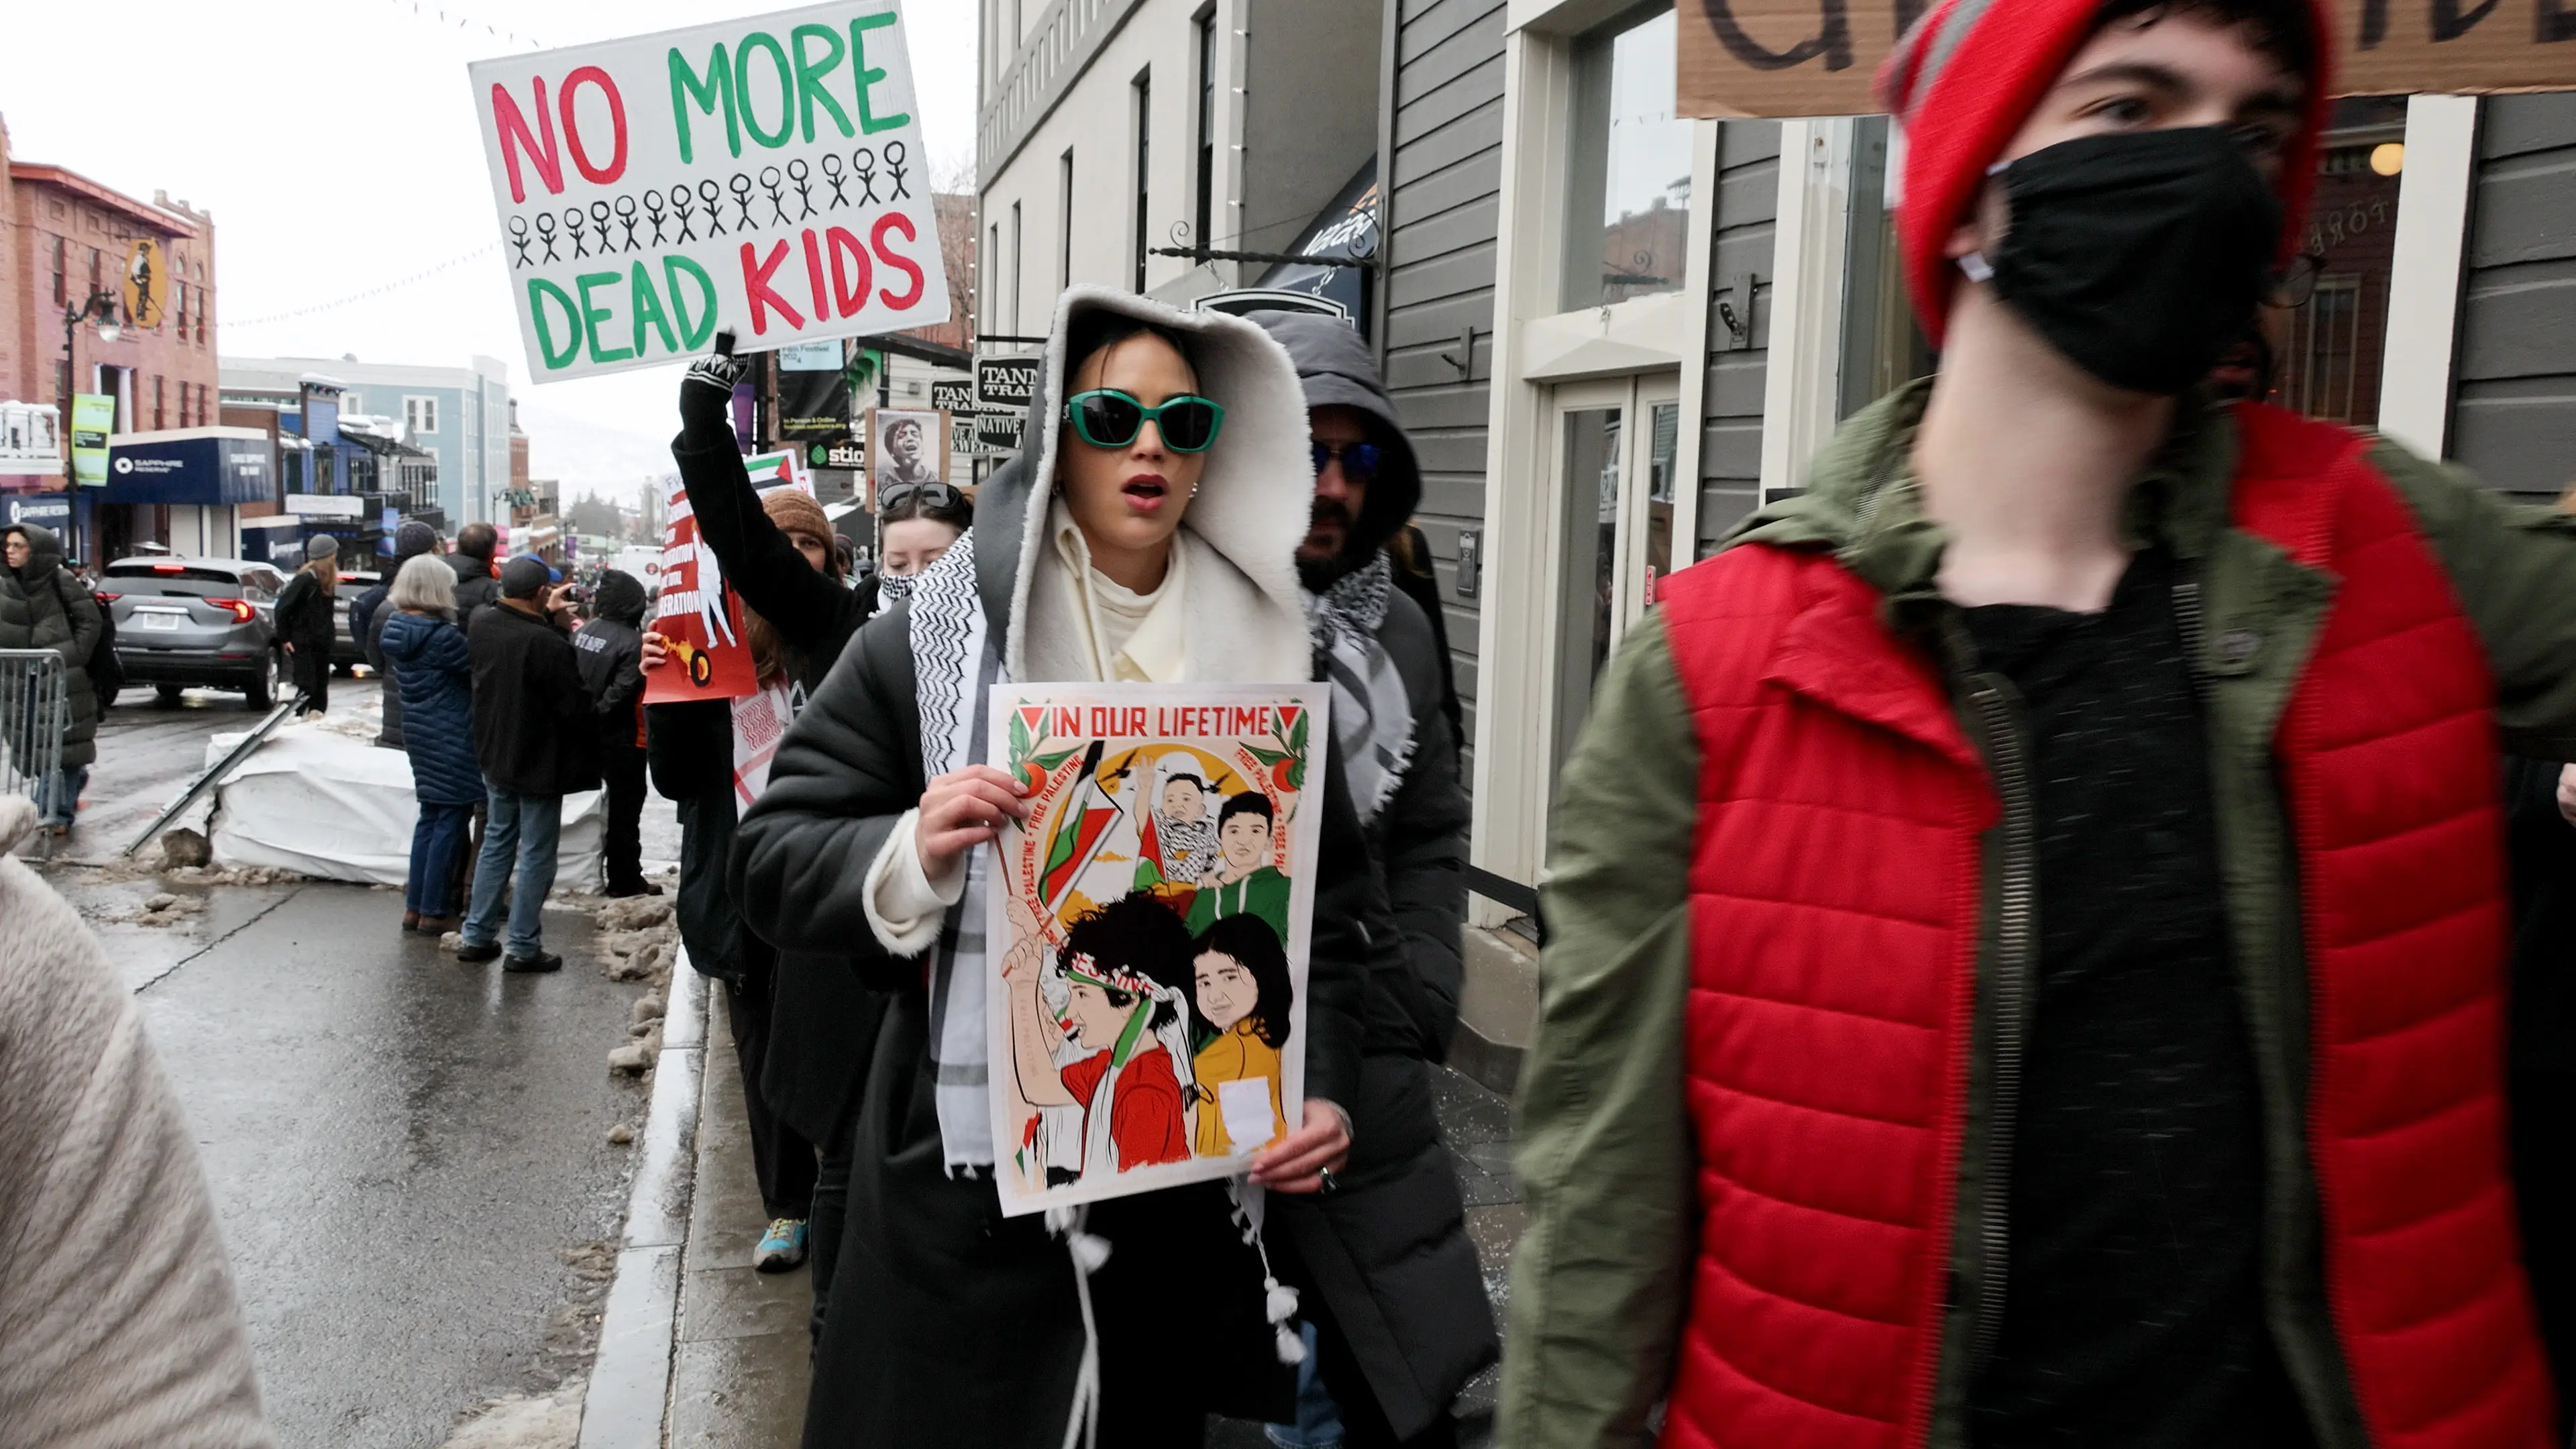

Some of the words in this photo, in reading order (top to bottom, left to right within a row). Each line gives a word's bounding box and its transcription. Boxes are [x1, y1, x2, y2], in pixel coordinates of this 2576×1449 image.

[492, 66, 629, 204] NO
[668, 11, 911, 164] MORE
[527, 255, 718, 370] DEAD
[740, 212, 924, 335] KIDS
[800, 344, 829, 352] Festival
[979, 417, 1020, 434] NATIVE
[134, 460, 184, 468] SAPPHIRE
[828, 446, 864, 463] stio
[575, 633, 608, 653] STAFF
[1052, 706, 1081, 737] IN
[1091, 706, 1149, 737] OUR
[1159, 706, 1271, 737] LIFETIME
[1041, 754, 1084, 803] PALESTINE
[1234, 747, 1258, 771] FREE
[1274, 824, 1286, 850] FREE
[1028, 800, 1046, 830] FREE
[1022, 839, 1036, 896] PALESTINE
